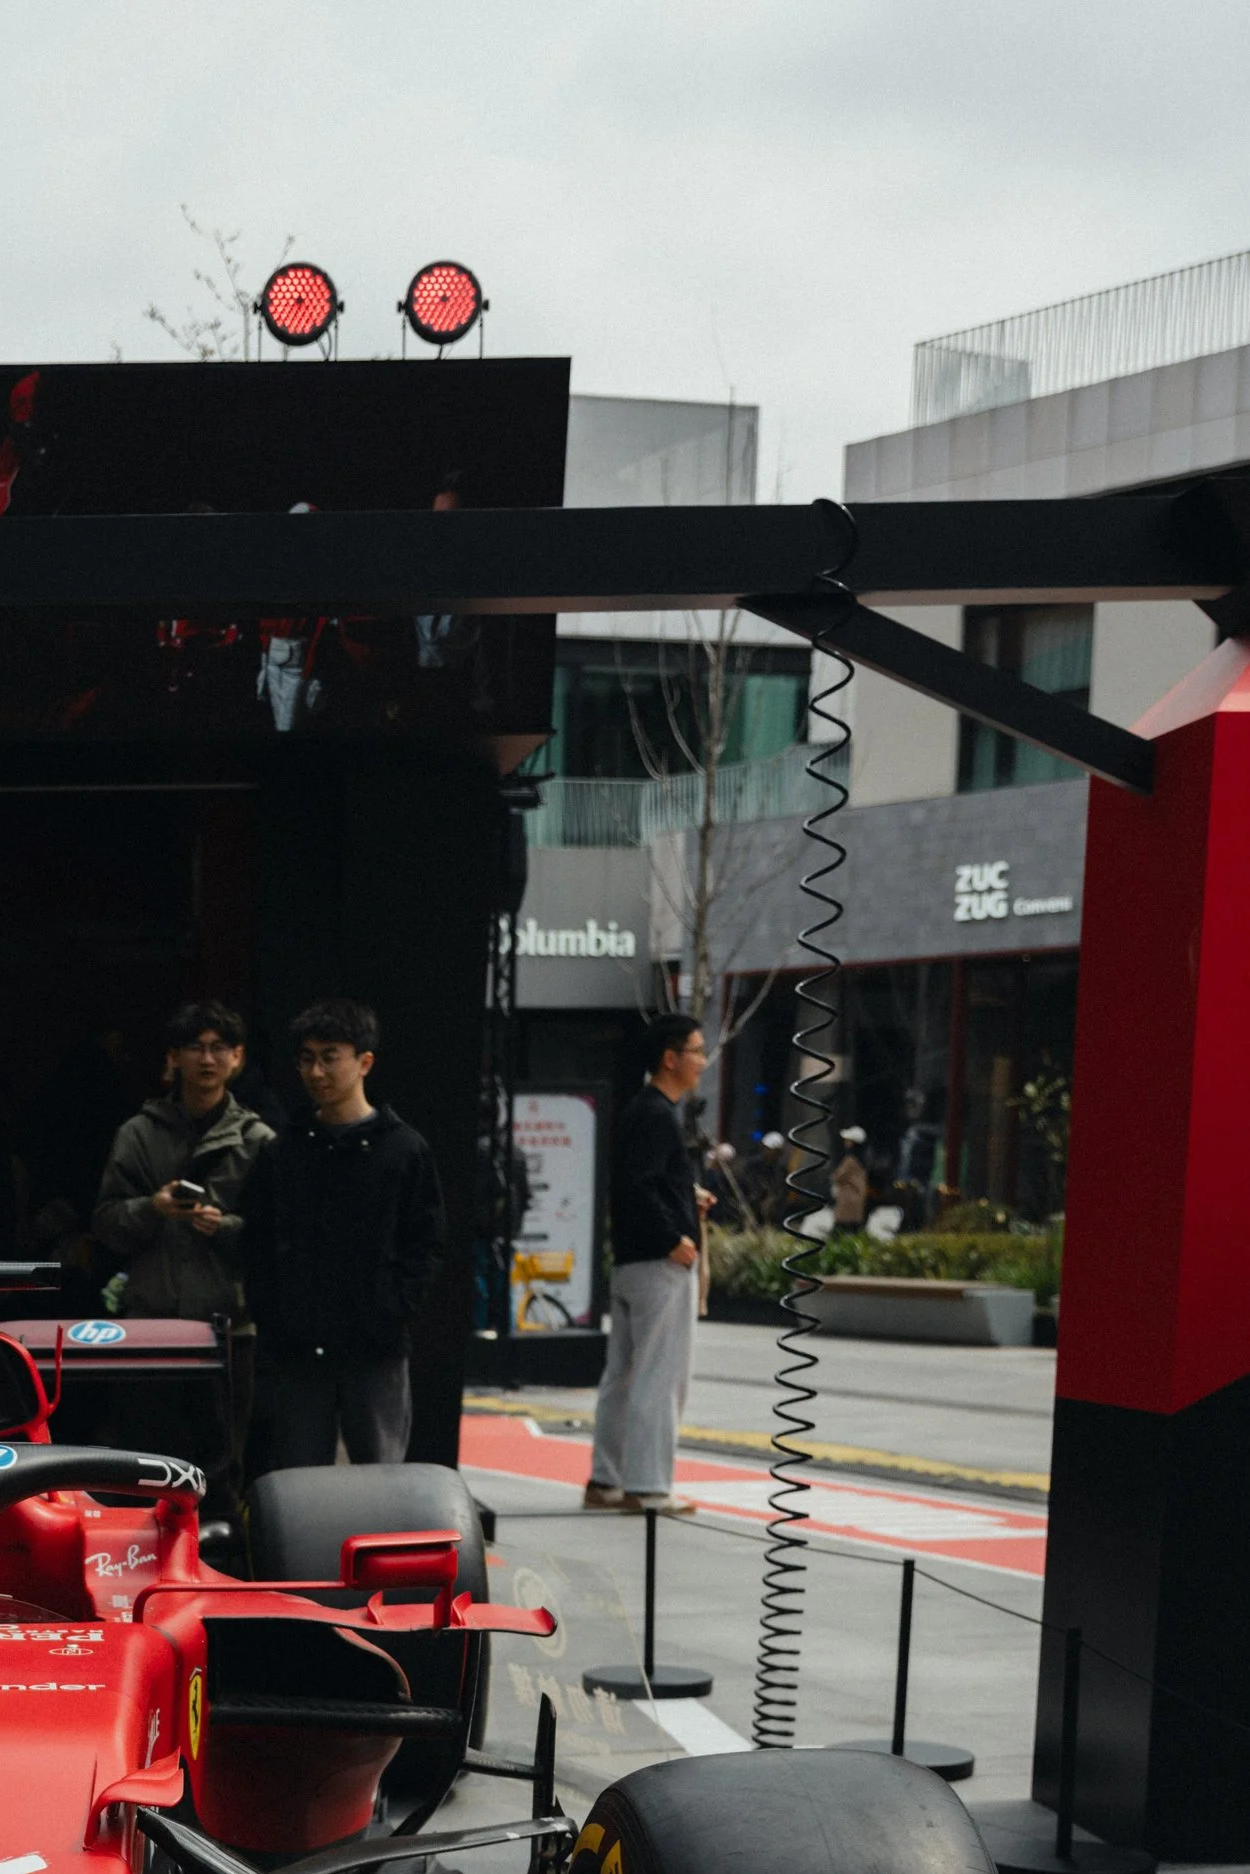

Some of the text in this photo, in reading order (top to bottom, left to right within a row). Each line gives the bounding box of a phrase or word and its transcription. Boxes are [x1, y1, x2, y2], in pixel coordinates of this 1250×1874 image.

[954, 860, 1010, 892] ZUC
[953, 890, 1009, 921] ZUG
[78, 1320, 118, 1344] hp
[84, 1544, 157, 1577] Ray-Ban
